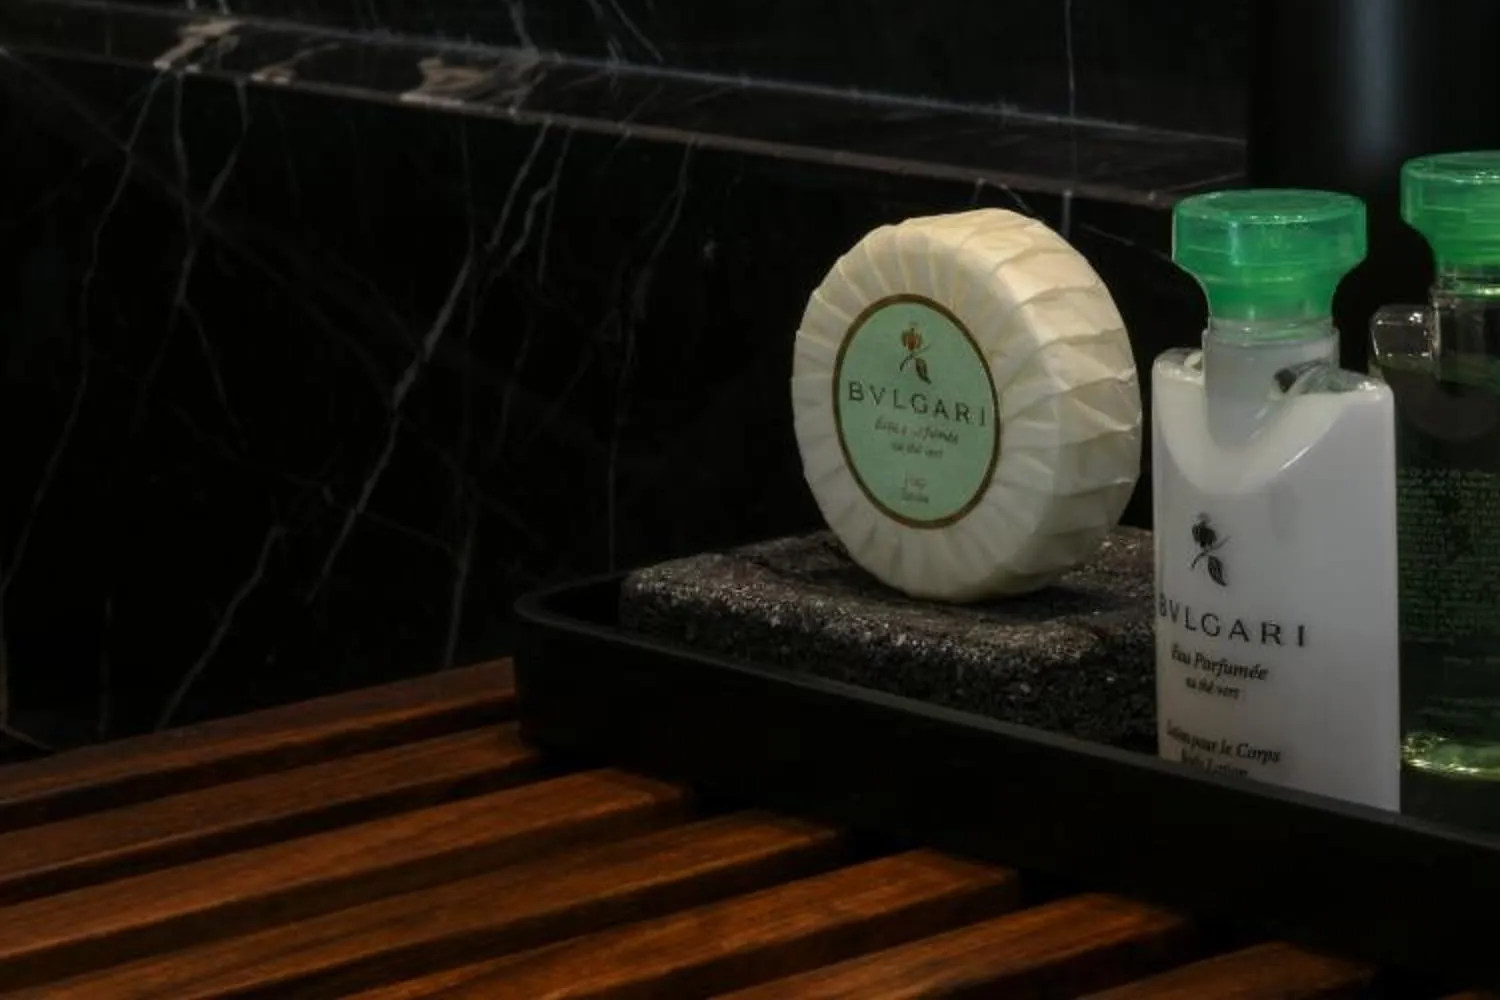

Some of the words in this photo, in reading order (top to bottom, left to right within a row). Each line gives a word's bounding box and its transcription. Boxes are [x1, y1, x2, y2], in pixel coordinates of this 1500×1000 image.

[847, 380, 987, 426] BVLGARI
[1157, 591, 1306, 648] BVLGARI
[1235, 742, 1281, 767] Corps
